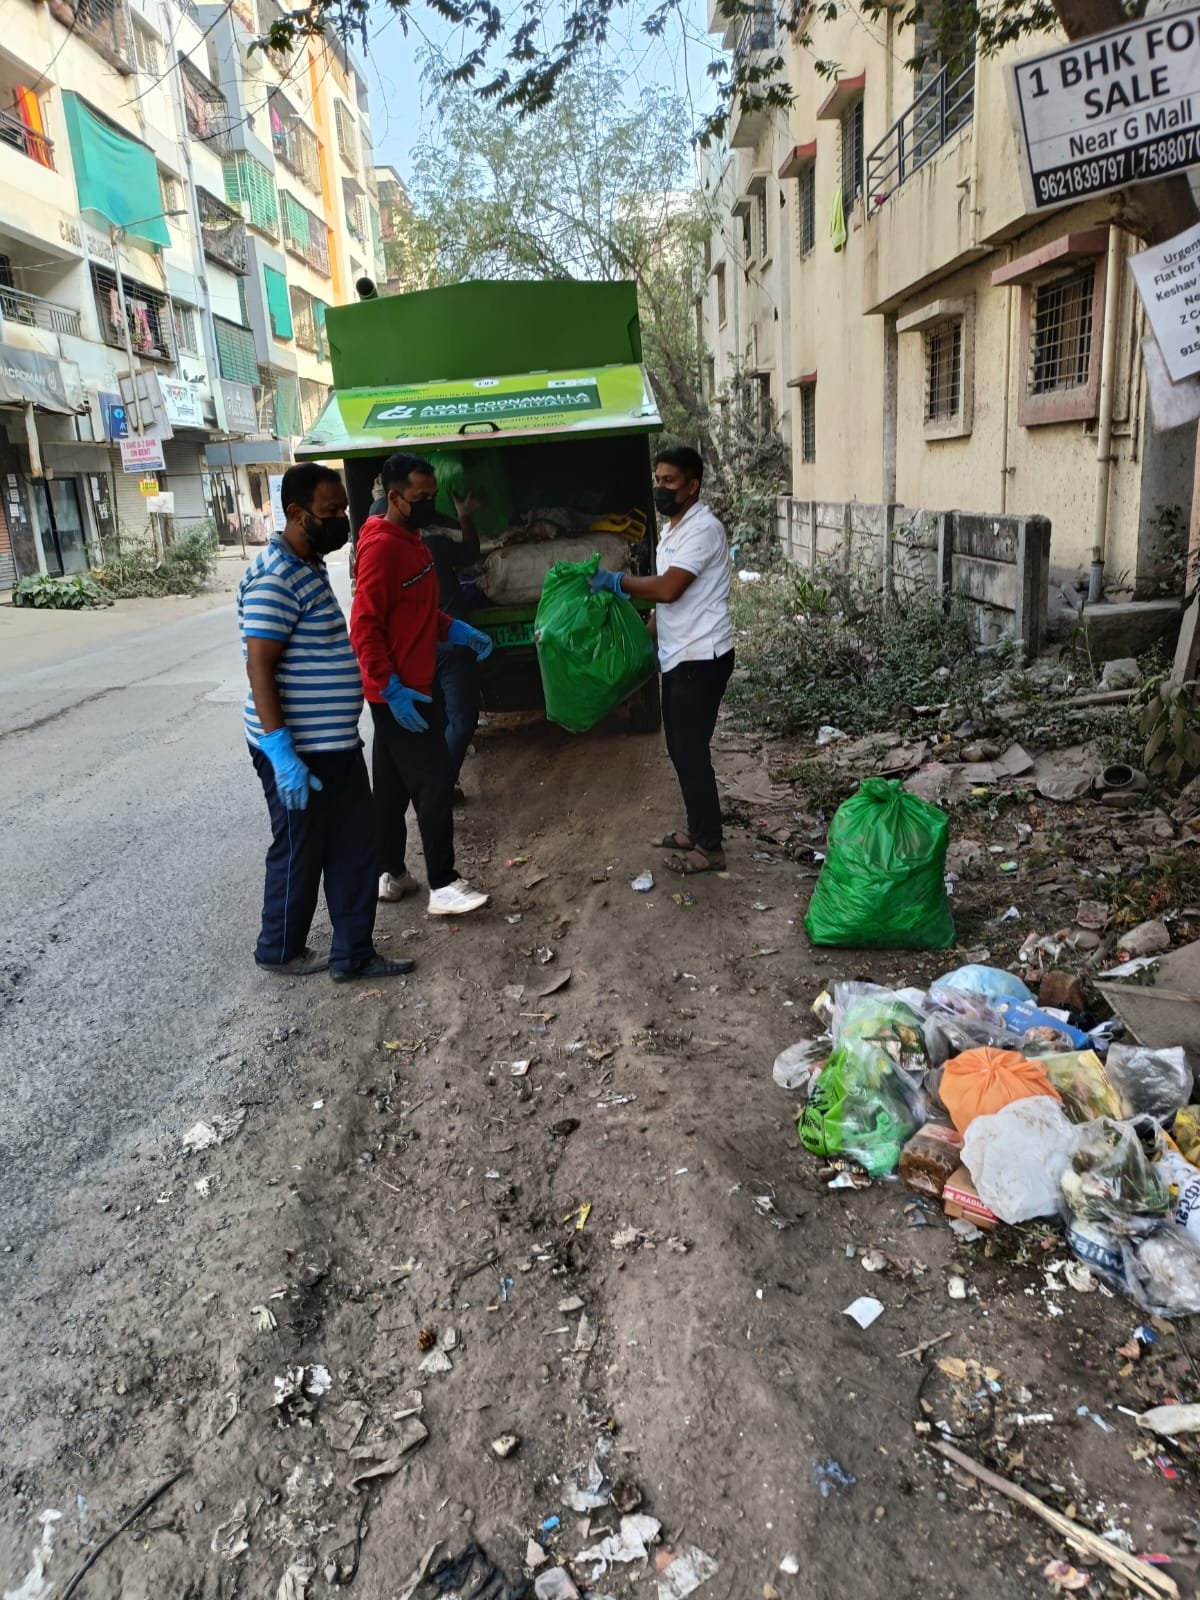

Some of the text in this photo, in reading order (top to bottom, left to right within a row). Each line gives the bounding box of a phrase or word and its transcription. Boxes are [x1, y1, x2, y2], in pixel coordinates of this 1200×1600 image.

[1029, 15, 1200, 99] 1 BHK FO
[1084, 65, 1171, 120] SALE
[1069, 98, 1193, 158] Near G Mall
[1039, 154, 1126, 200] 9621839797
[1154, 261, 1195, 286] Flat for
[1155, 277, 1197, 302] Keshav
[1179, 314, 1188, 325] Z
[421, 403, 469, 411] ADAR
